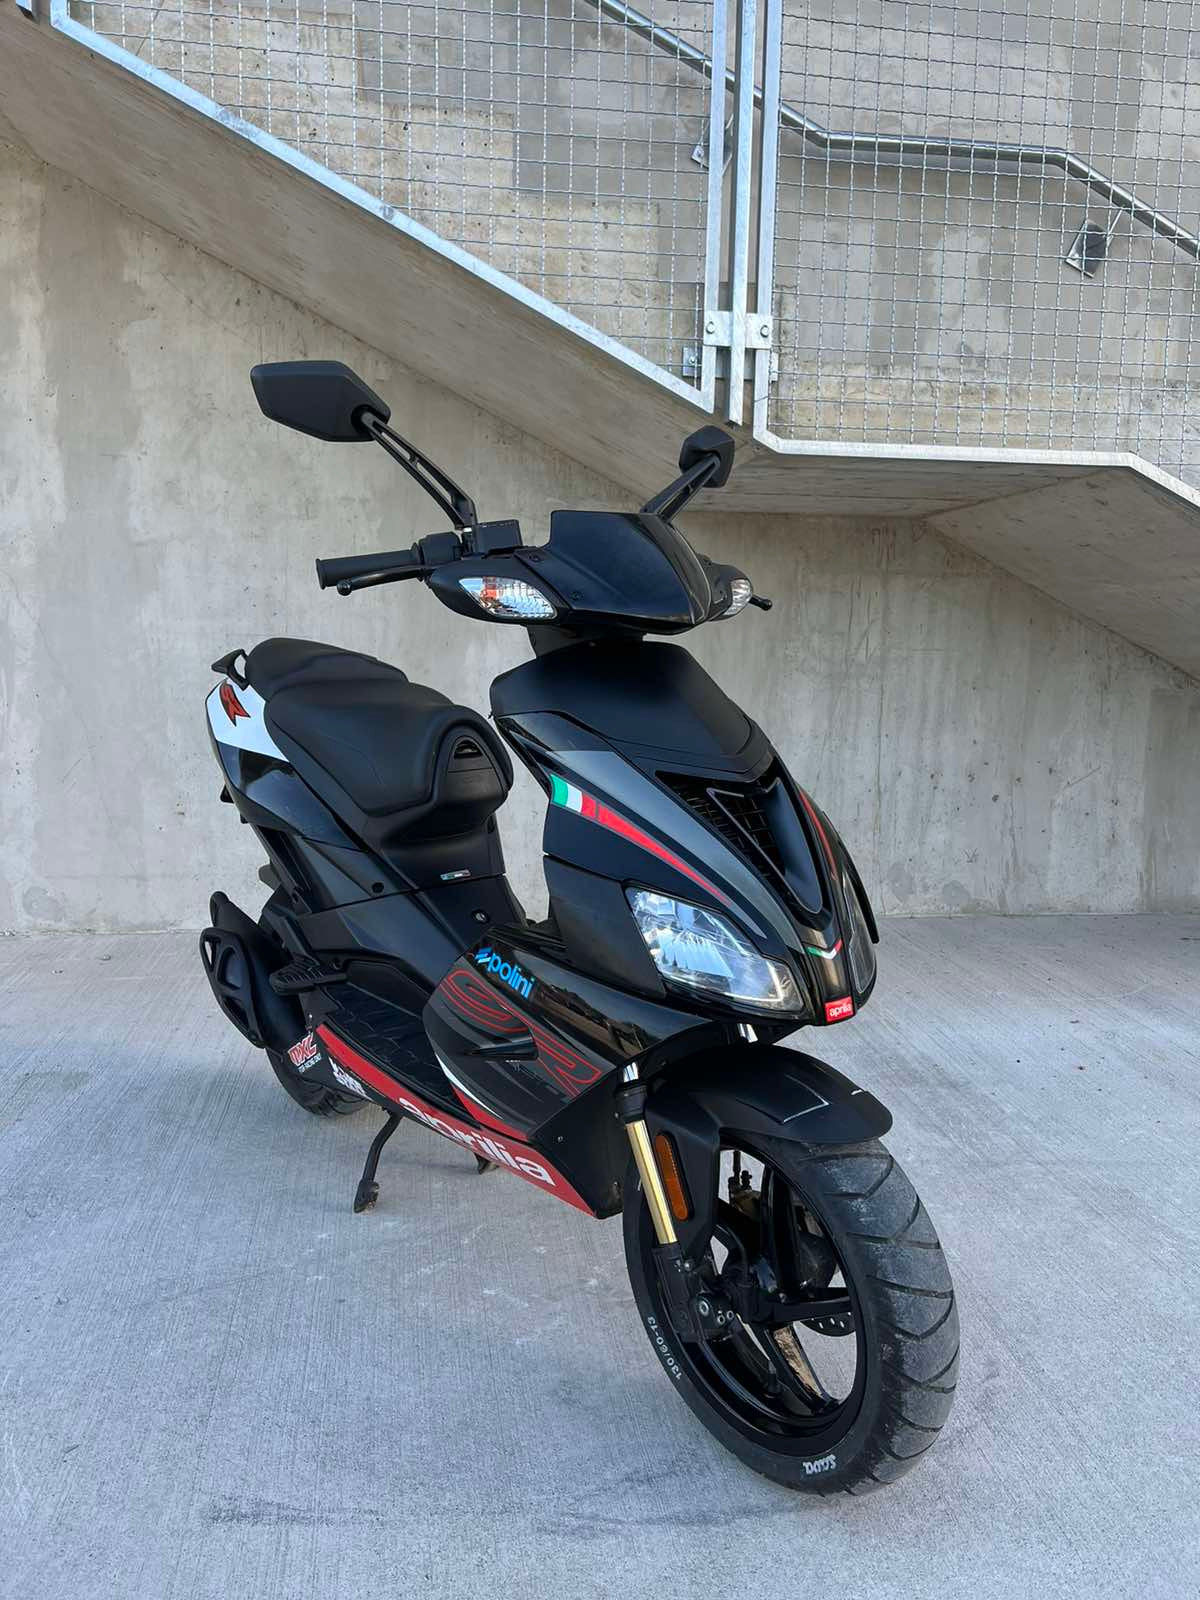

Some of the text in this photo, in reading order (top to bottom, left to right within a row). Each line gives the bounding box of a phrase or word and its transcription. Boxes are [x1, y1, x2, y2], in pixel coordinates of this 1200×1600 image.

[486, 953, 535, 1000] polini
[829, 1002, 852, 1017] aprilia
[399, 1097, 556, 1186] aprilia
[647, 1316, 682, 1380] 130/60-13
